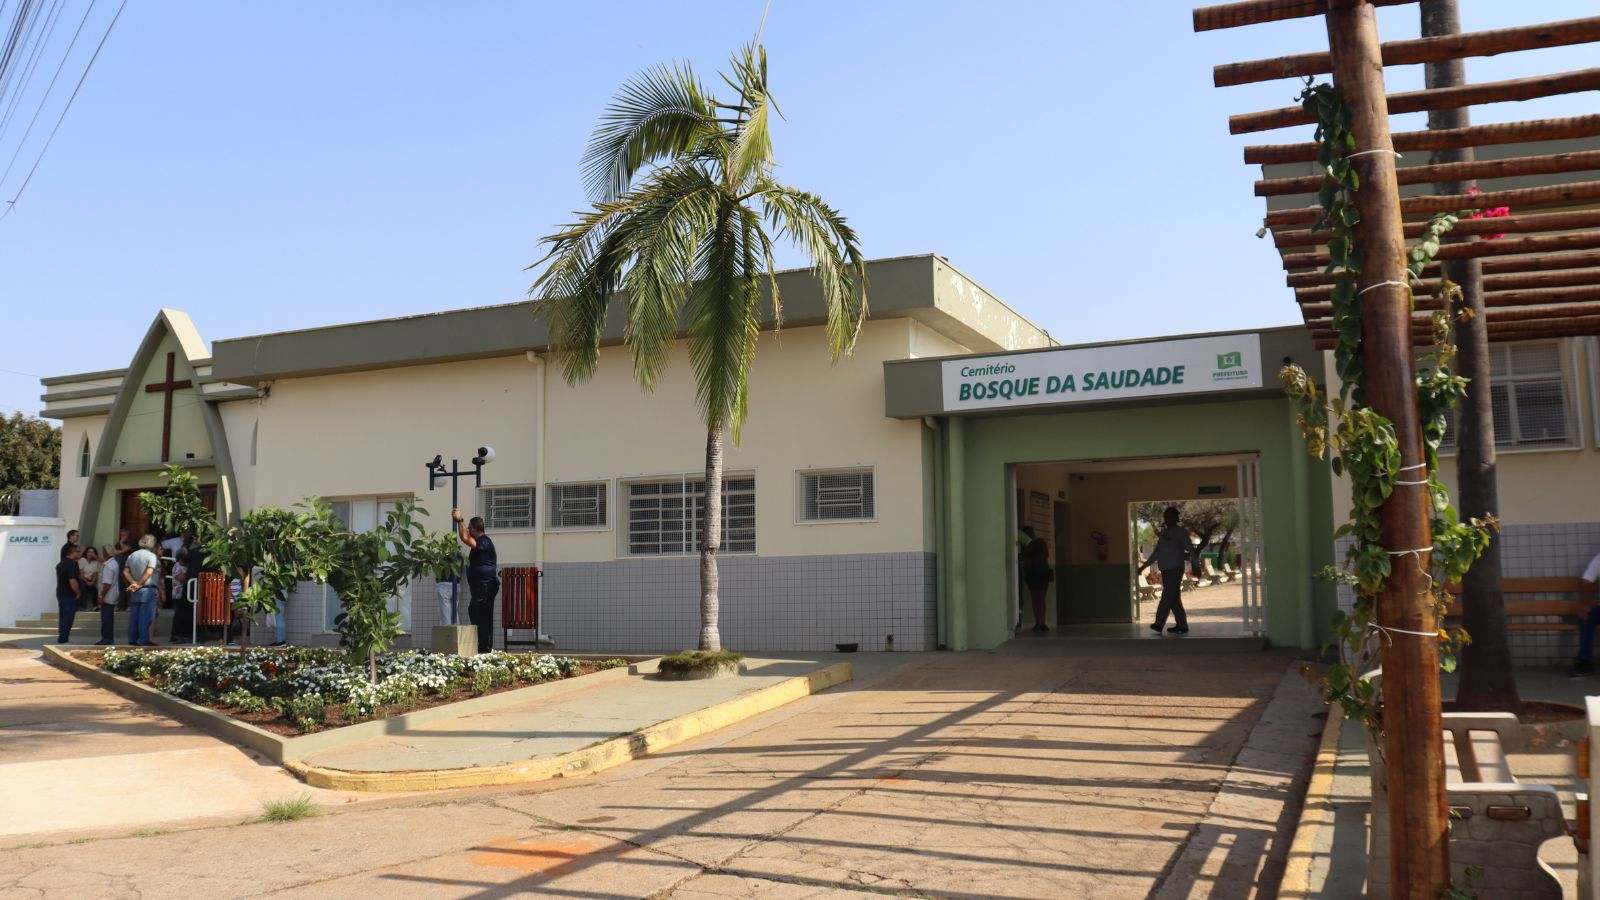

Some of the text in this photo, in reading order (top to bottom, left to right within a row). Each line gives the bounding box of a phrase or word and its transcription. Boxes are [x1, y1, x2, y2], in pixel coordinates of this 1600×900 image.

[961, 363, 1016, 377] Cemitério
[959, 365, 1185, 401] BOSQUE DA SAUDADE
[9, 535, 38, 543] CAPELA
